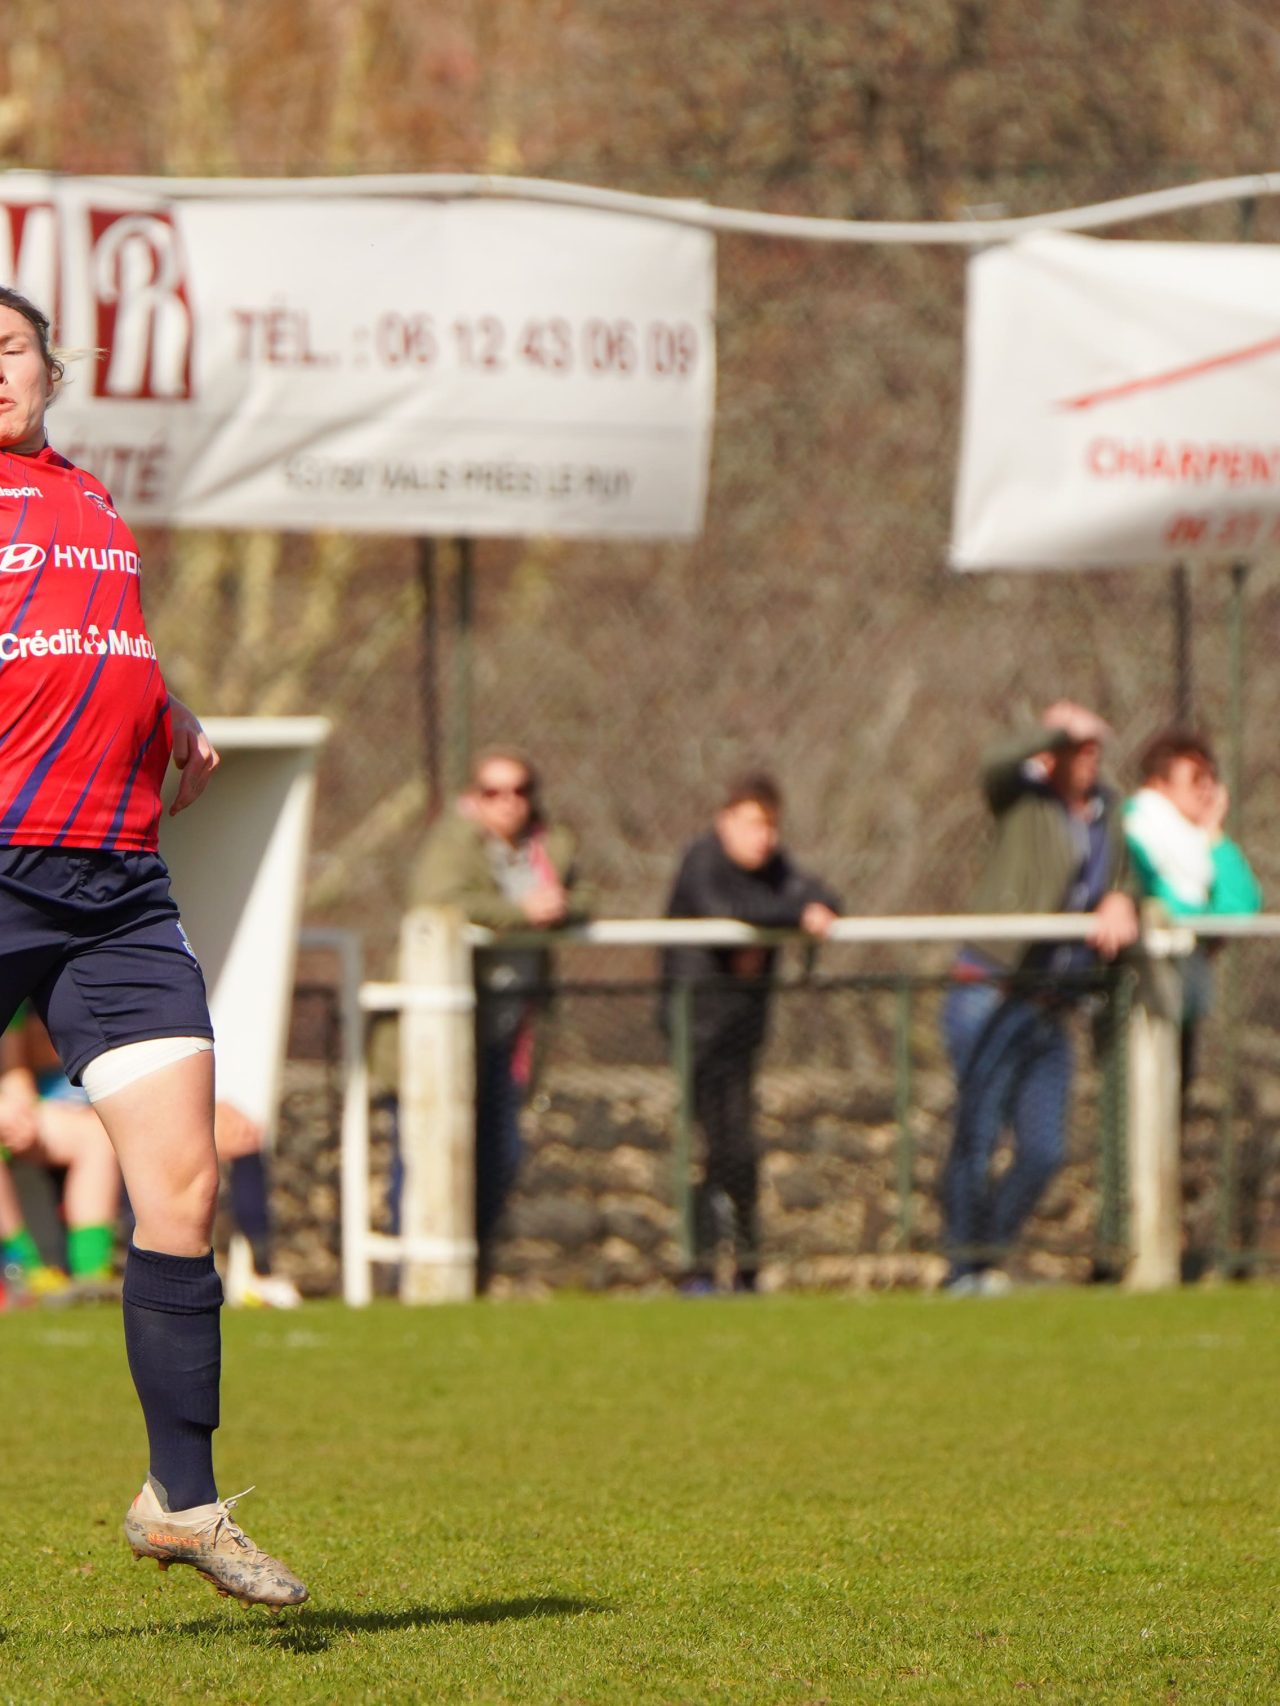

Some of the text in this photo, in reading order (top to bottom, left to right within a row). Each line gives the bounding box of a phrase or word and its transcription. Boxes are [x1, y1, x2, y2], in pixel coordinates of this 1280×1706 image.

[376, 311, 438, 367] 06
[451, 314, 506, 370] 12
[147, 1532, 201, 1547] NEMESIS
